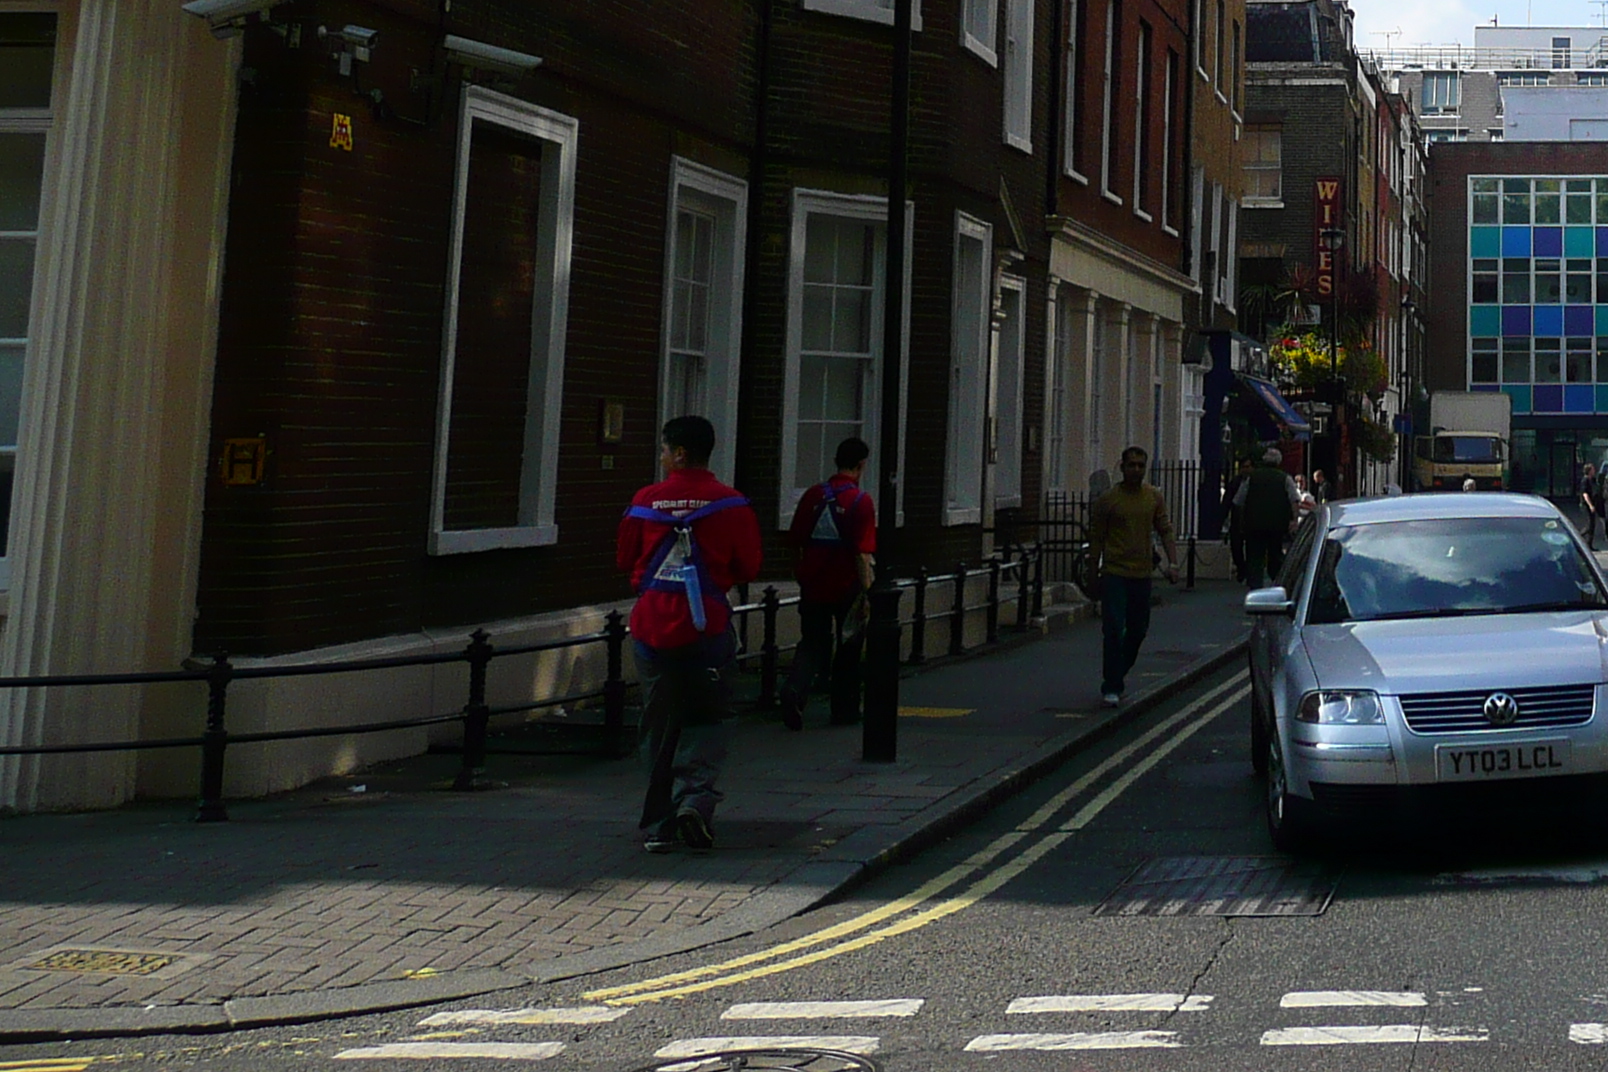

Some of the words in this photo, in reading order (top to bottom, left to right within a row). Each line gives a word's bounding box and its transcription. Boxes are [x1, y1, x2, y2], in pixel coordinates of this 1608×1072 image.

[229, 443, 258, 480] H
[1450, 748, 1511, 774] YT03
[1517, 745, 1562, 770] LCL
